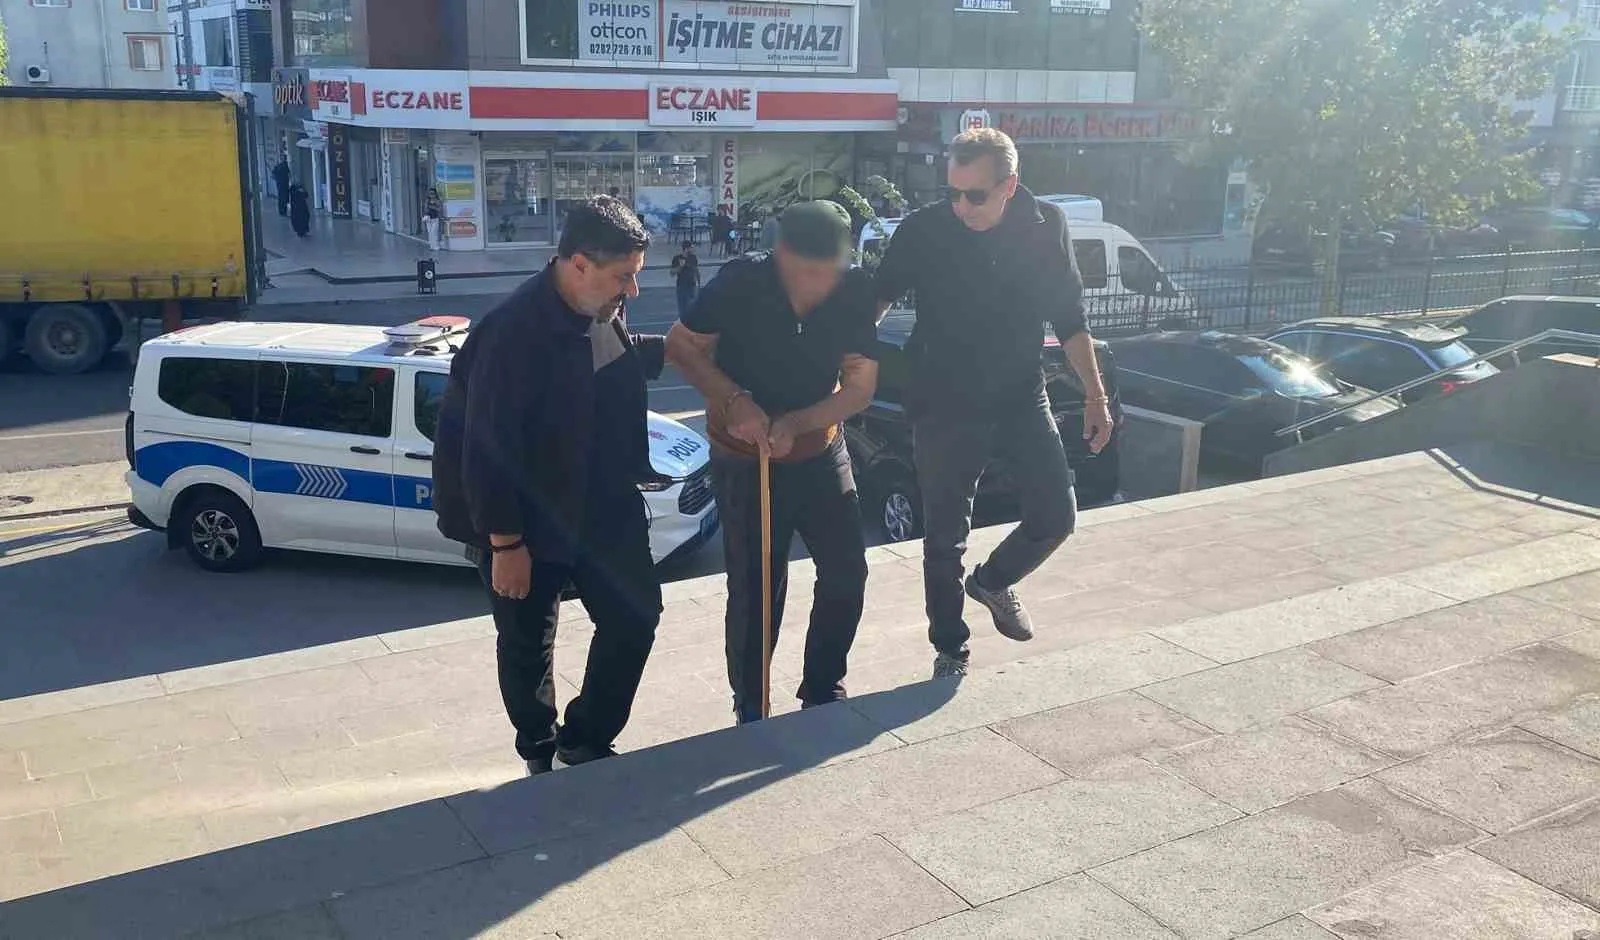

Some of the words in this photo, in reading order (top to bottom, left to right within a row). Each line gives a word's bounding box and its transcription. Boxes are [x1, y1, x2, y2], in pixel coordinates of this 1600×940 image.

[588, 3, 651, 18] PHILIPS
[590, 22, 647, 40] oticon
[667, 12, 755, 54] İŞİTME
[274, 73, 303, 117] optik
[372, 89, 463, 110] ECZANE
[657, 87, 752, 110] ECZANE
[691, 111, 718, 125] IŞIK
[723, 139, 735, 217] ECZAN
[415, 484, 434, 505] P
